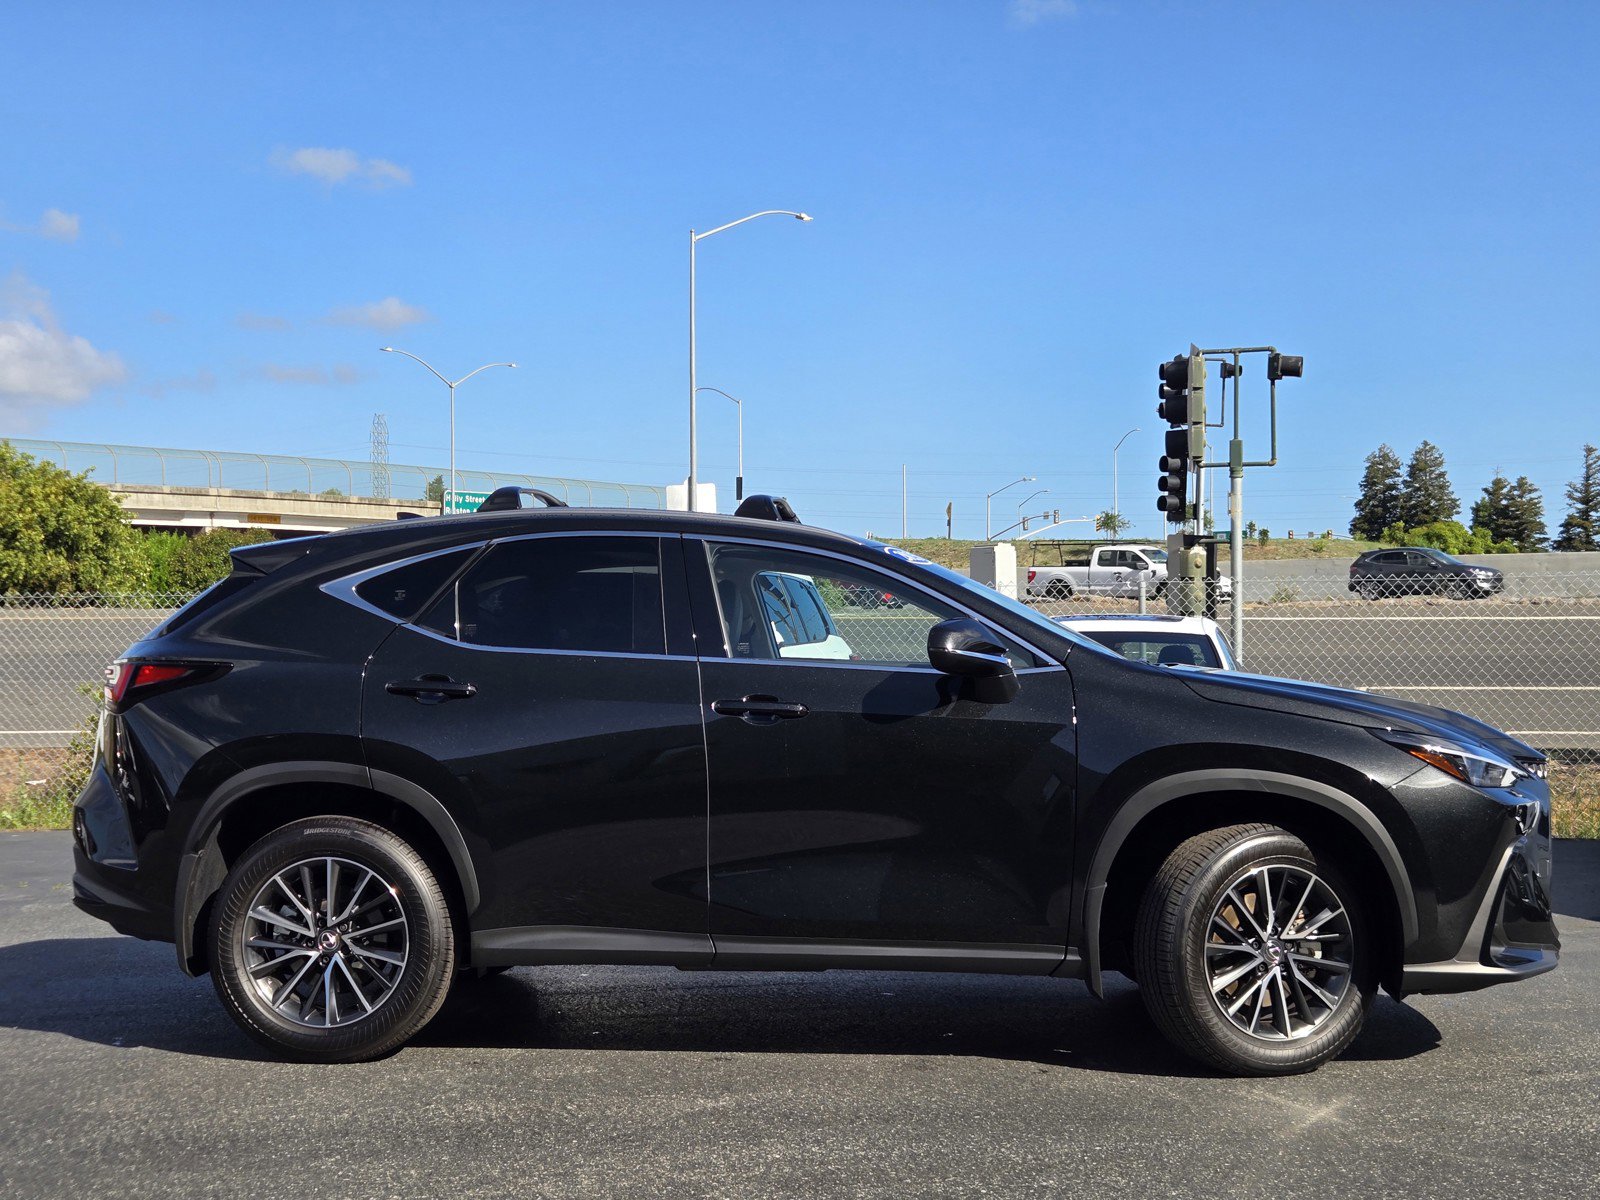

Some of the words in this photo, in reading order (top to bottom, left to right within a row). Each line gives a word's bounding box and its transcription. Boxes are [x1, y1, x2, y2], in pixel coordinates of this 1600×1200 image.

[445, 494, 463, 503] Hlly
[465, 495, 486, 503] Street
[303, 827, 351, 836] BRIDGESTONE
